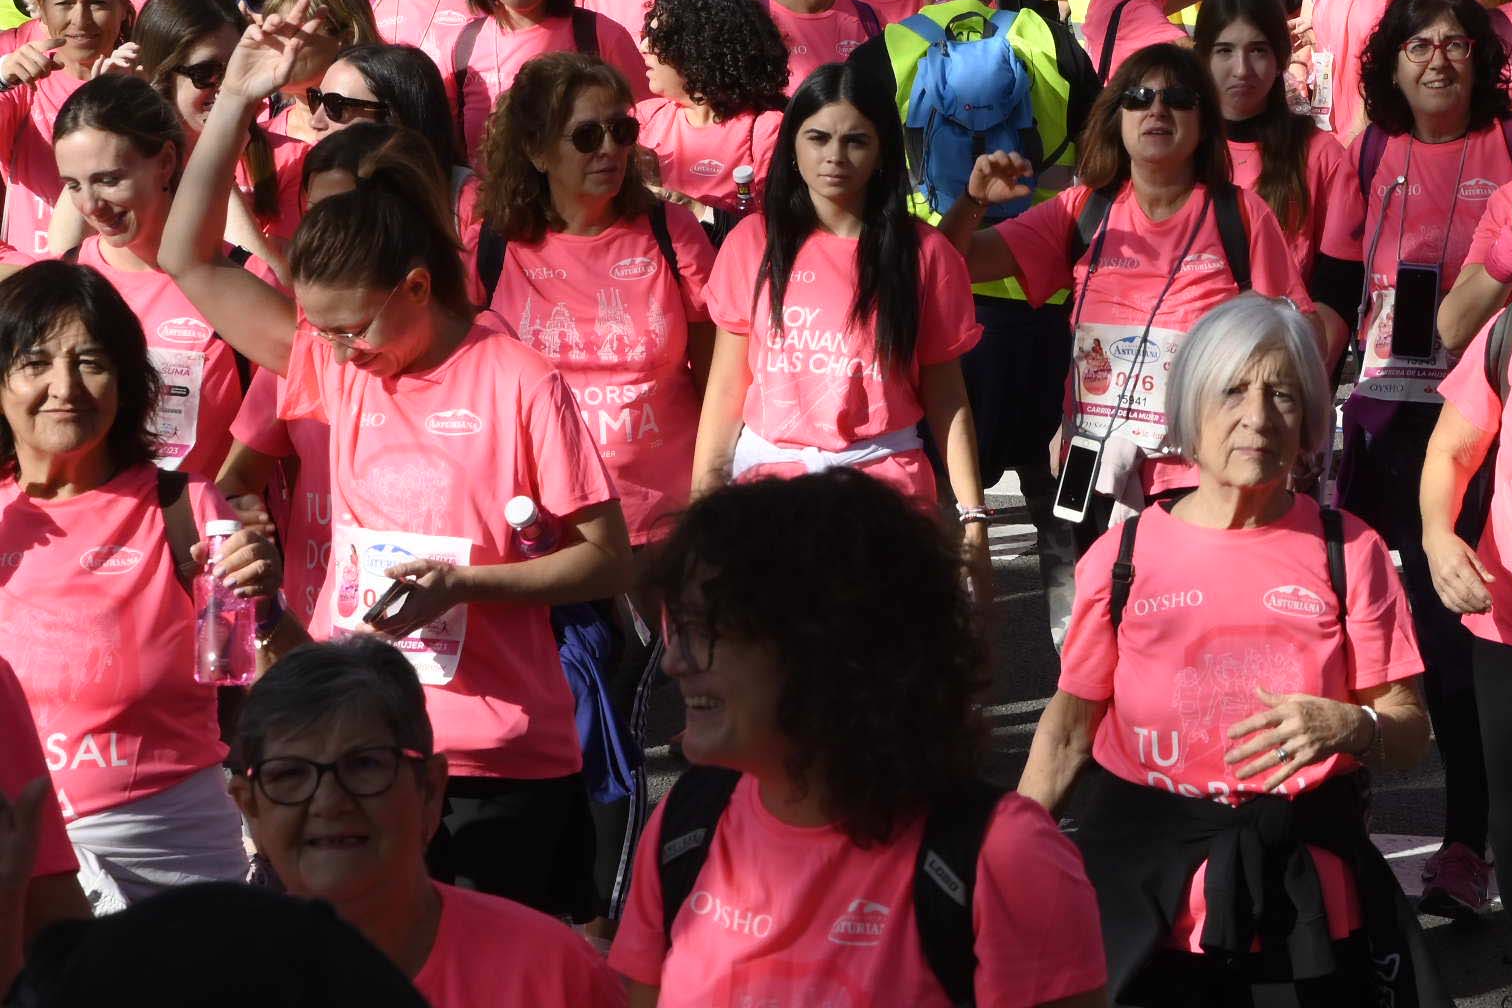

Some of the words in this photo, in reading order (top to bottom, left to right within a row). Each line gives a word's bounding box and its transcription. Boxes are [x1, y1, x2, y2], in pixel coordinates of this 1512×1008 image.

[160, 366, 191, 377] SUMA
[766, 351, 803, 374] LAS
[808, 353, 883, 383] CHICA
[1134, 589, 1204, 617] OYSHO
[1269, 594, 1321, 614] ASTURIANA
[393, 640, 425, 650] MUJER
[1133, 726, 1180, 767] TU
